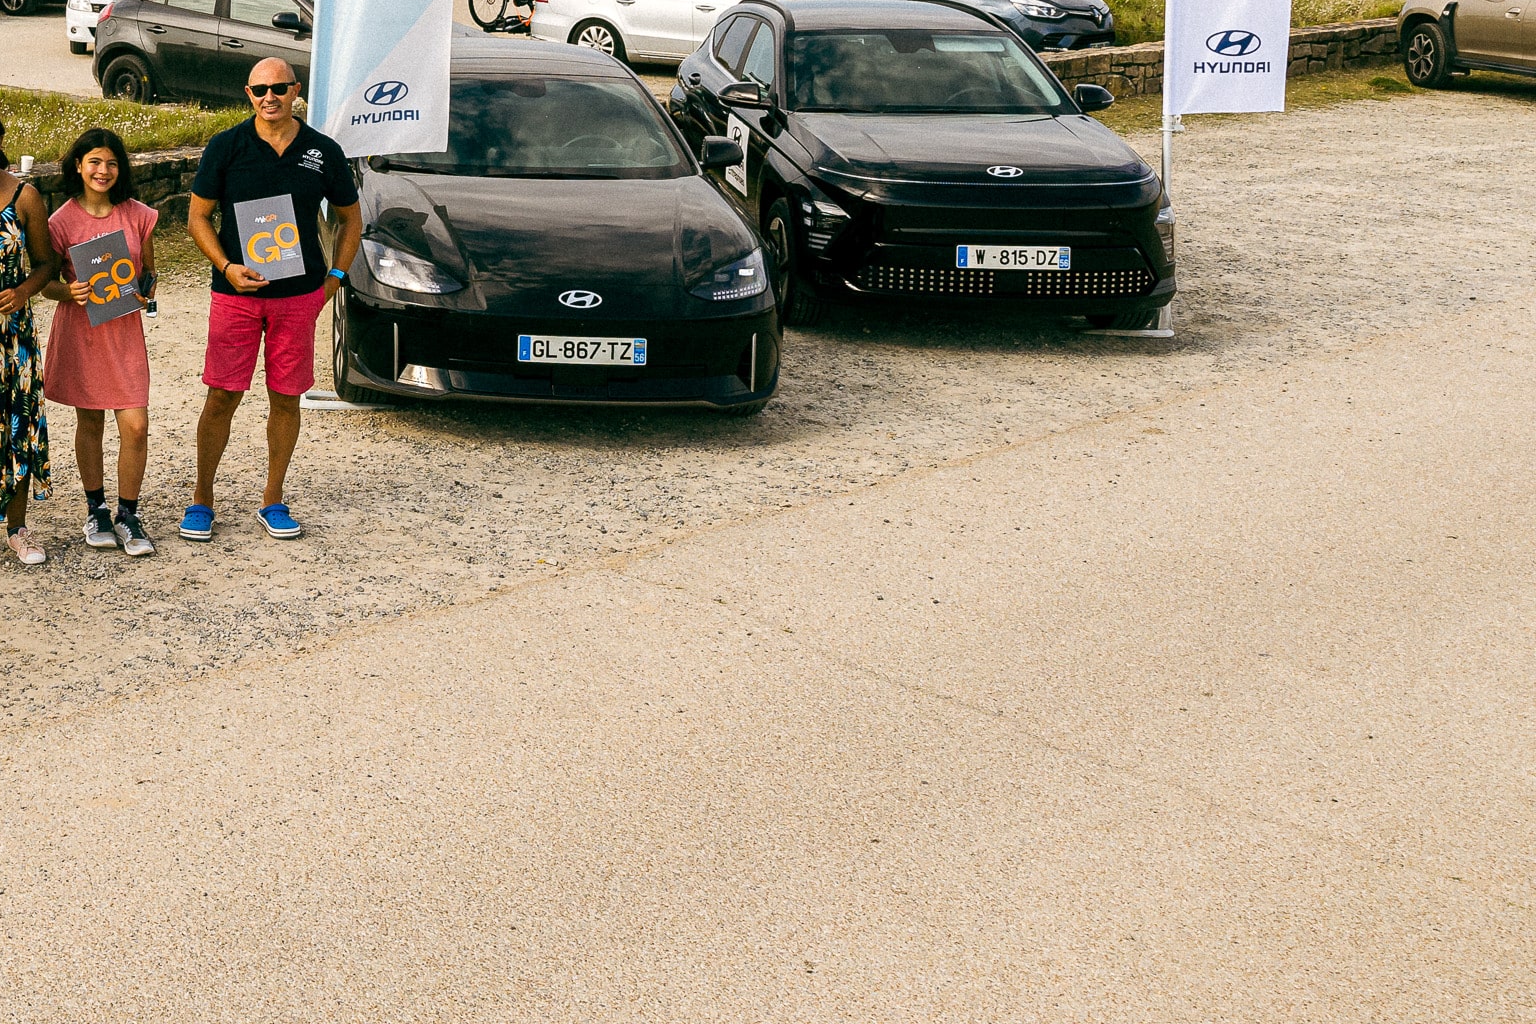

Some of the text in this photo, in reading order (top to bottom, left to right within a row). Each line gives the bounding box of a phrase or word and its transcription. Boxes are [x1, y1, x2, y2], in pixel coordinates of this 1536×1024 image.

[1193, 61, 1271, 74] HYUNDAI
[351, 109, 420, 126] HYUNDAI
[246, 222, 300, 264] GO
[88, 258, 136, 305] GO
[532, 339, 632, 361] GL-867-TZ
[634, 352, 645, 362] 56
